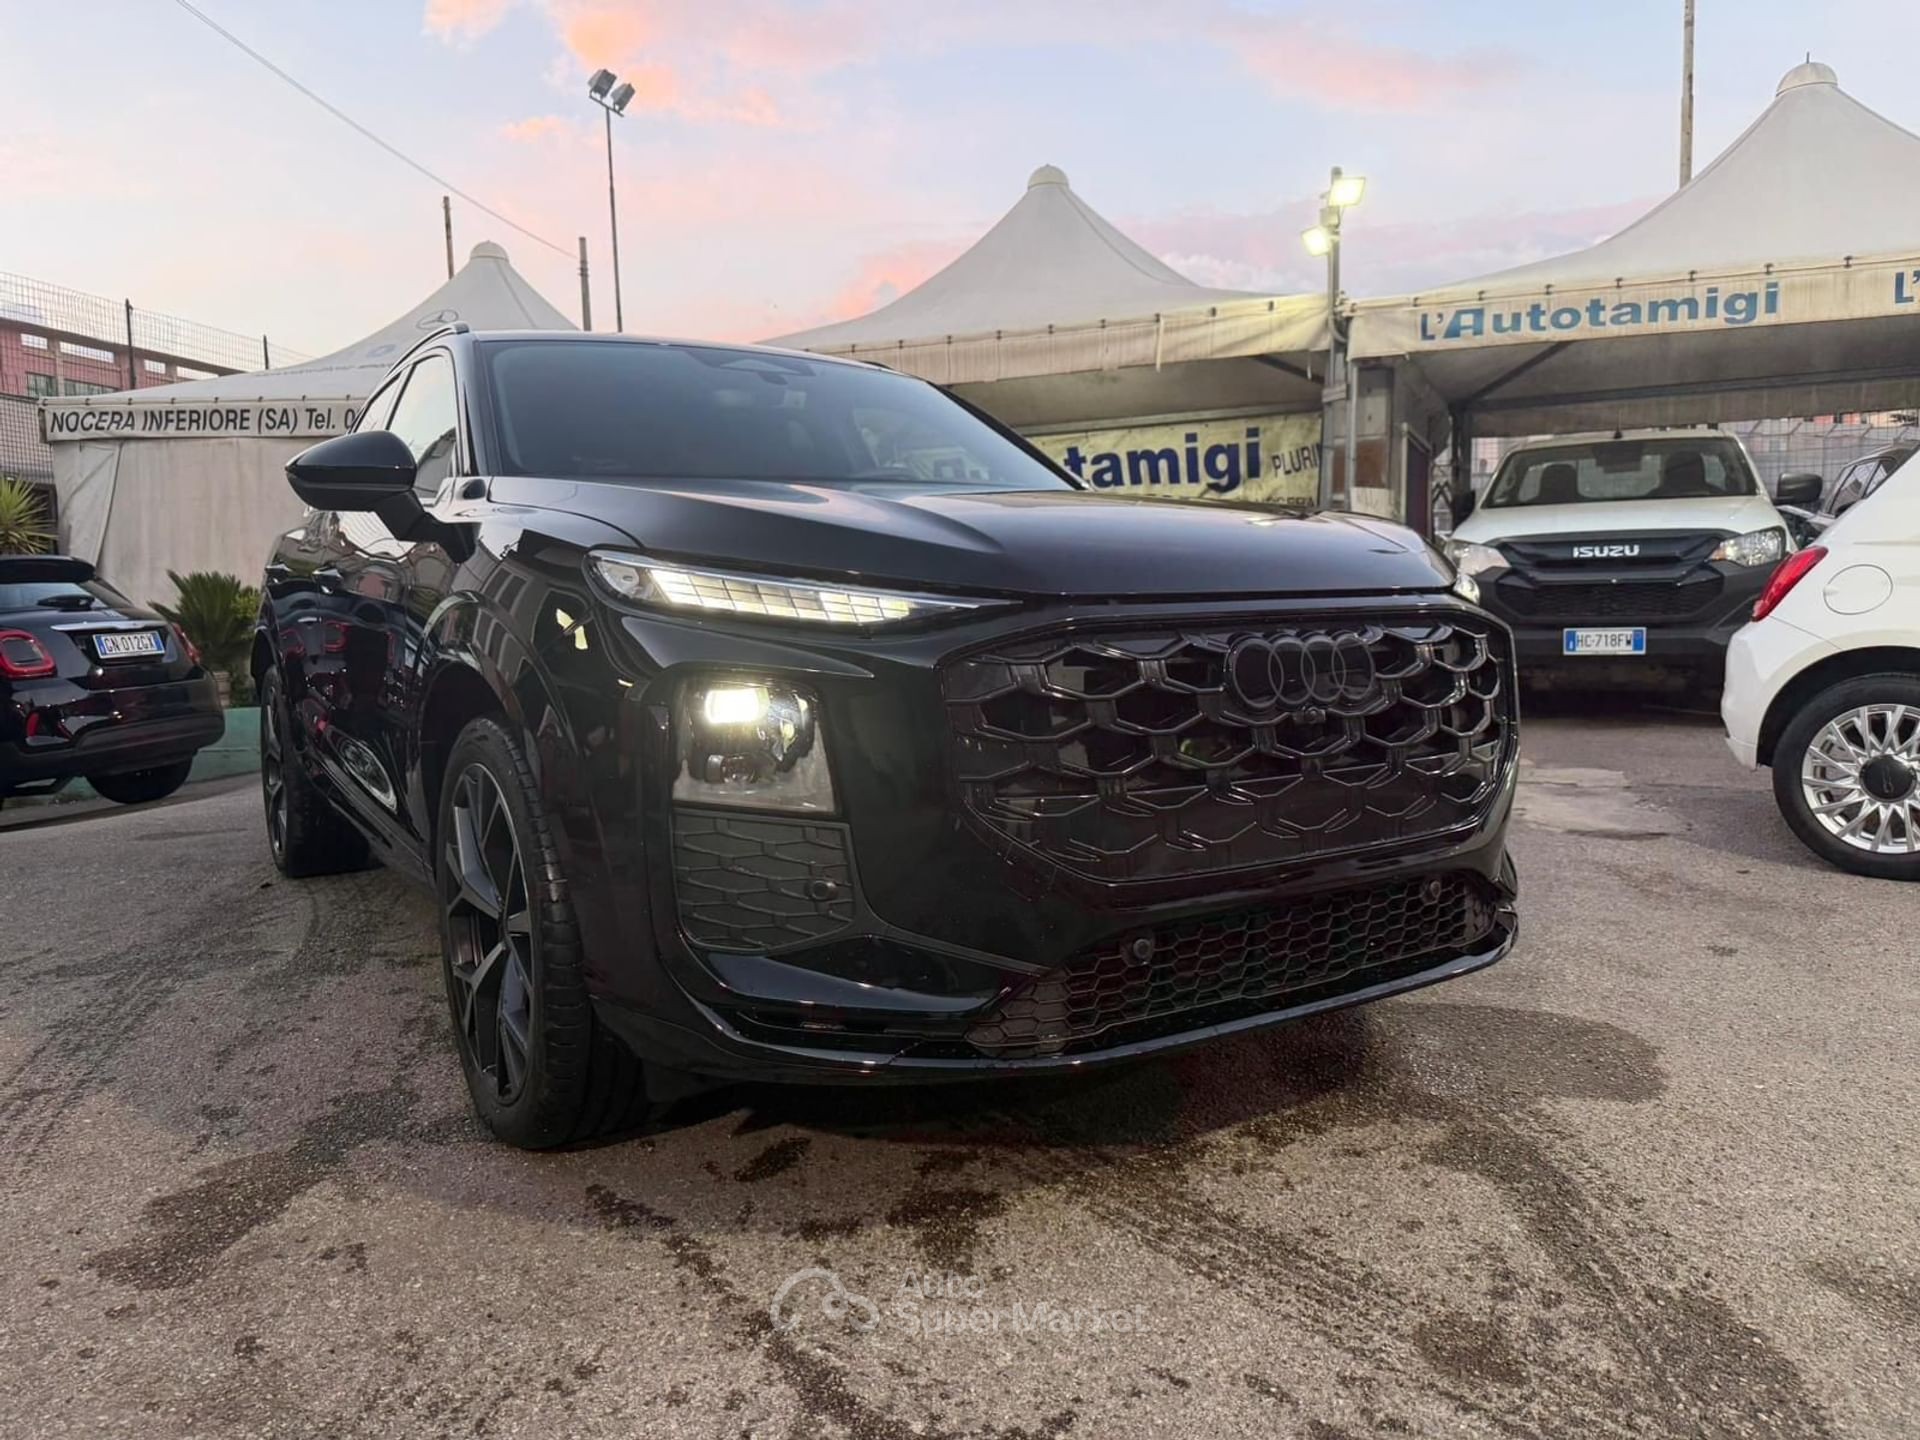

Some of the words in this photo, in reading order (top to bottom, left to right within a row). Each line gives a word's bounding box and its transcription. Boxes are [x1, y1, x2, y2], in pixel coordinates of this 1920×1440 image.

[1421, 281, 1779, 341] L'Autotamigi
[50, 409, 135, 433] NOCERA
[142, 408, 251, 431] INFERIORE
[258, 407, 298, 434] (SA)
[305, 408, 336, 430] Tel.
[1572, 544, 1640, 558] ISUZU
